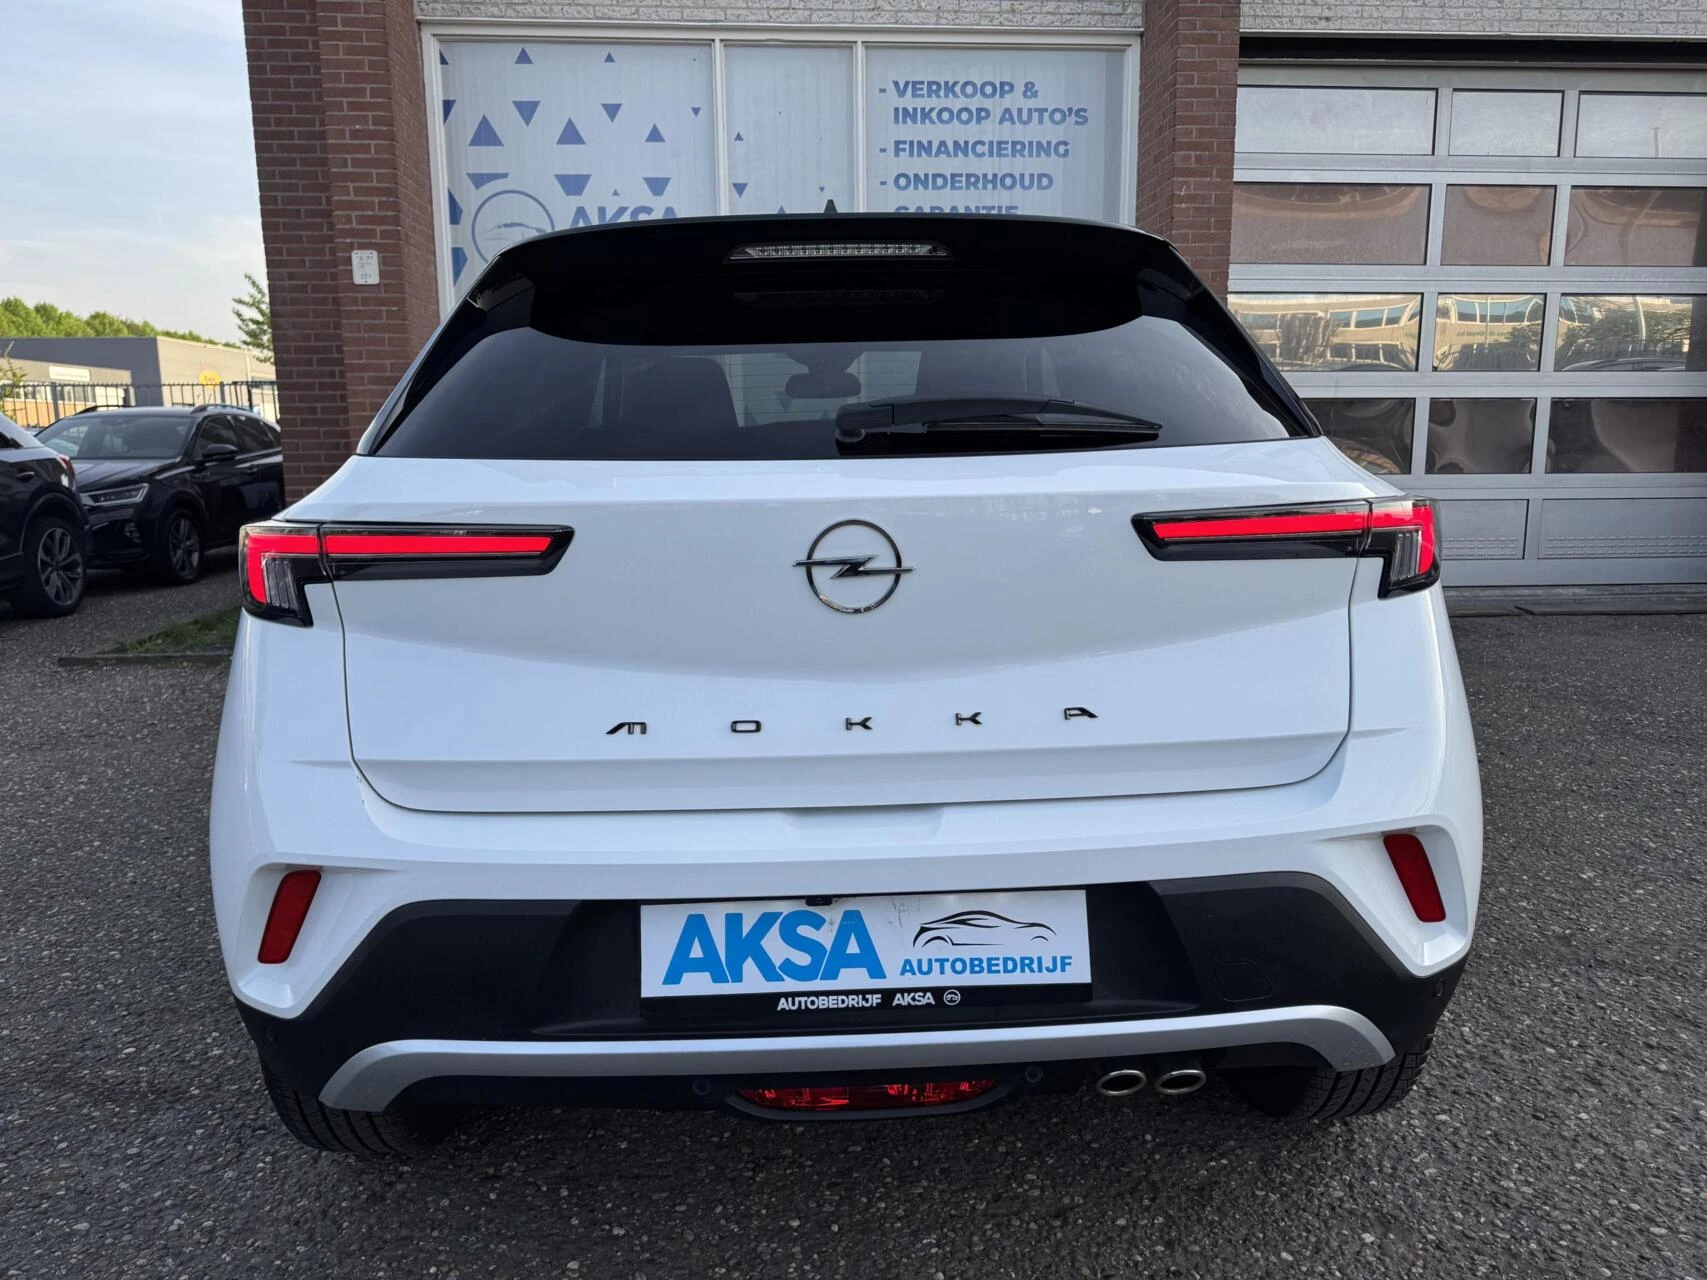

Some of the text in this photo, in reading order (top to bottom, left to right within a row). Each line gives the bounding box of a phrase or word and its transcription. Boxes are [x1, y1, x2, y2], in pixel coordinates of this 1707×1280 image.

[892, 80, 1015, 99] VERKOOP
[1021, 81, 1039, 100] &
[893, 107, 1089, 126] INKOOP AUTO'S
[893, 140, 1071, 159] FINANCIERING
[893, 172, 1054, 191] ONDERHOUD
[605, 706, 1099, 736] MOKKA
[662, 908, 887, 985] AKSA
[899, 954, 1073, 976] AUTOBEDRIJF
[776, 991, 936, 1011] AUTOBEDRIJF AKSA
